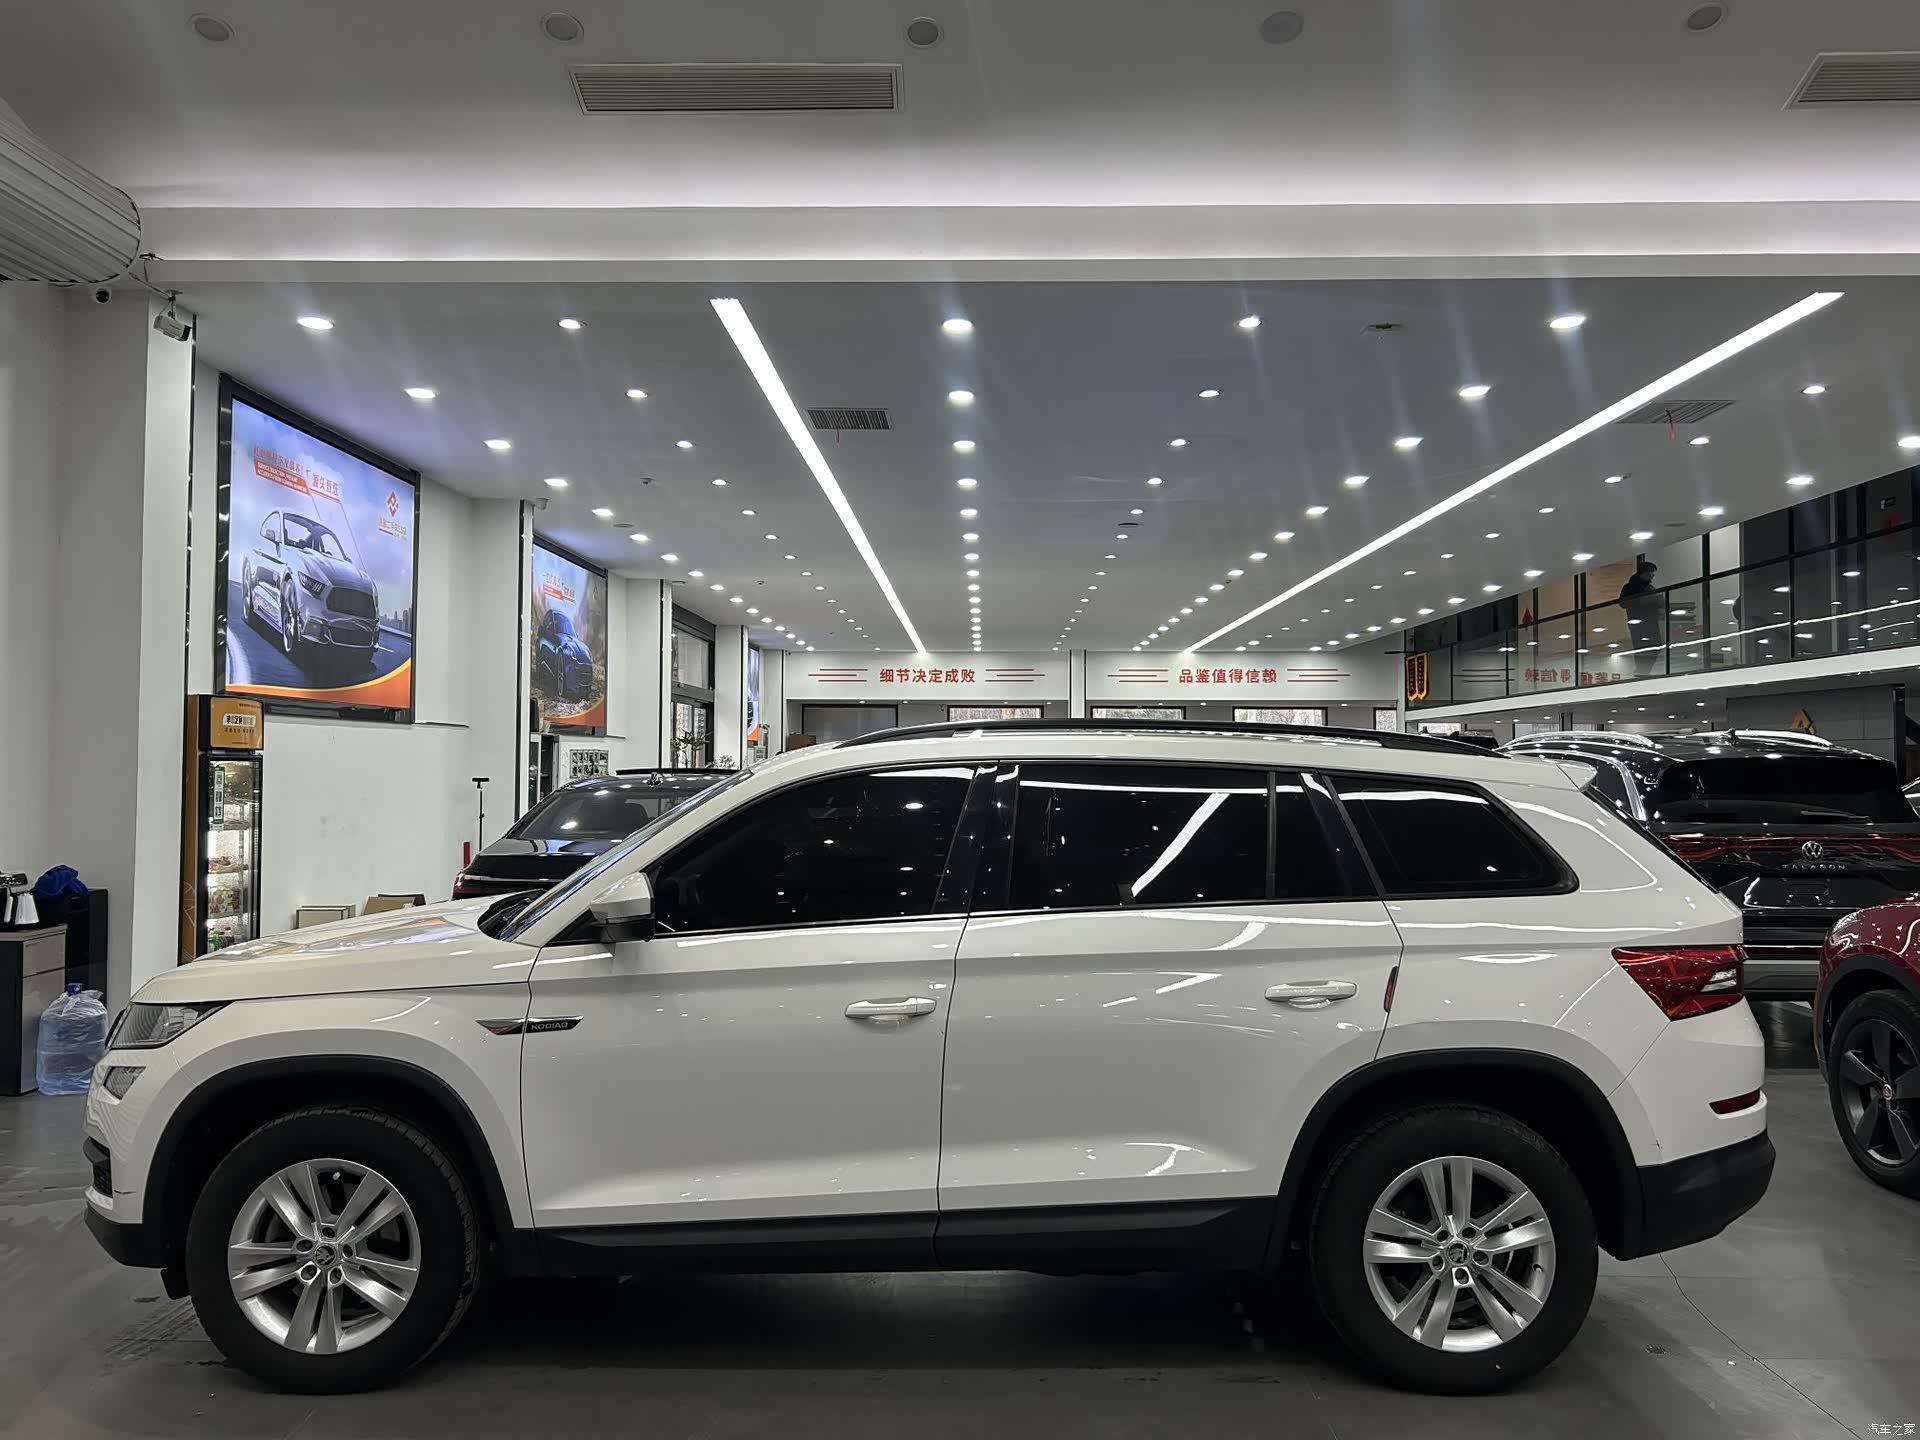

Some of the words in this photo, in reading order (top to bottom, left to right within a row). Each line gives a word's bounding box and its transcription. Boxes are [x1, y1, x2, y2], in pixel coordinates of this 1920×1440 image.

[879, 668, 975, 683] 细节决定成败
[1178, 668, 1277, 683] 品鉴值得信赖
[531, 1021, 569, 1030] KODIAQ
